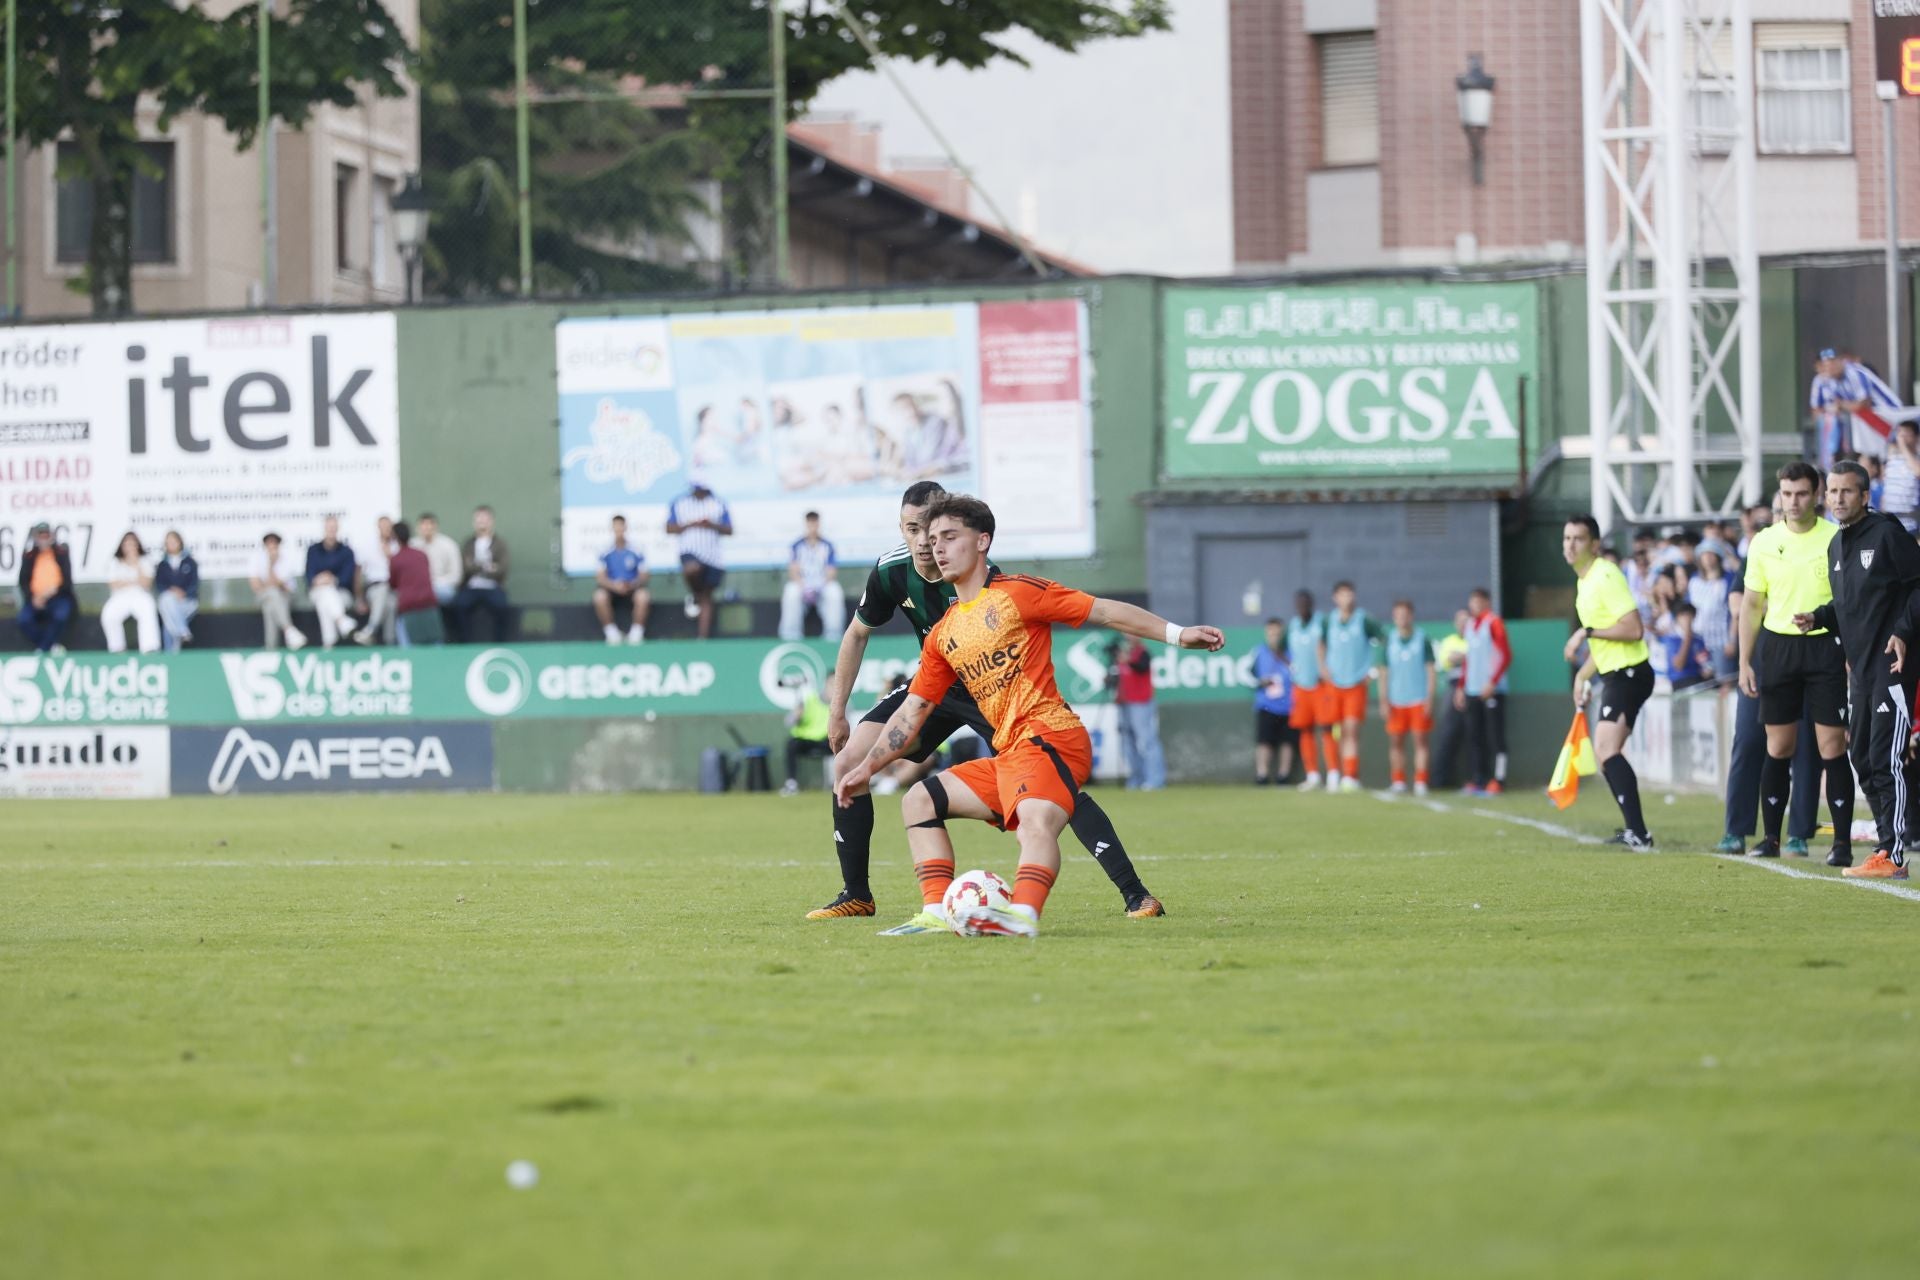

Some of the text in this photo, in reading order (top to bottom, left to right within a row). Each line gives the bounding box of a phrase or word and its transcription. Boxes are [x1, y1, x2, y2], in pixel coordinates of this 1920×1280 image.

[1186, 340, 1520, 369] DECORACIONES Y REFORMAS
[127, 335, 377, 453] itek
[1186, 365, 1519, 444] ZOGSA
[0, 457, 92, 482] LIDAD
[11, 490, 94, 510] COCINA
[43, 657, 169, 698] Viuda
[286, 652, 413, 696] Viuda
[538, 661, 715, 700] GESCRAP
[963, 643, 1021, 681] tvitec
[43, 694, 169, 721] de Sainz
[286, 691, 413, 717] de Sainz
[283, 735, 453, 780] AFESA
